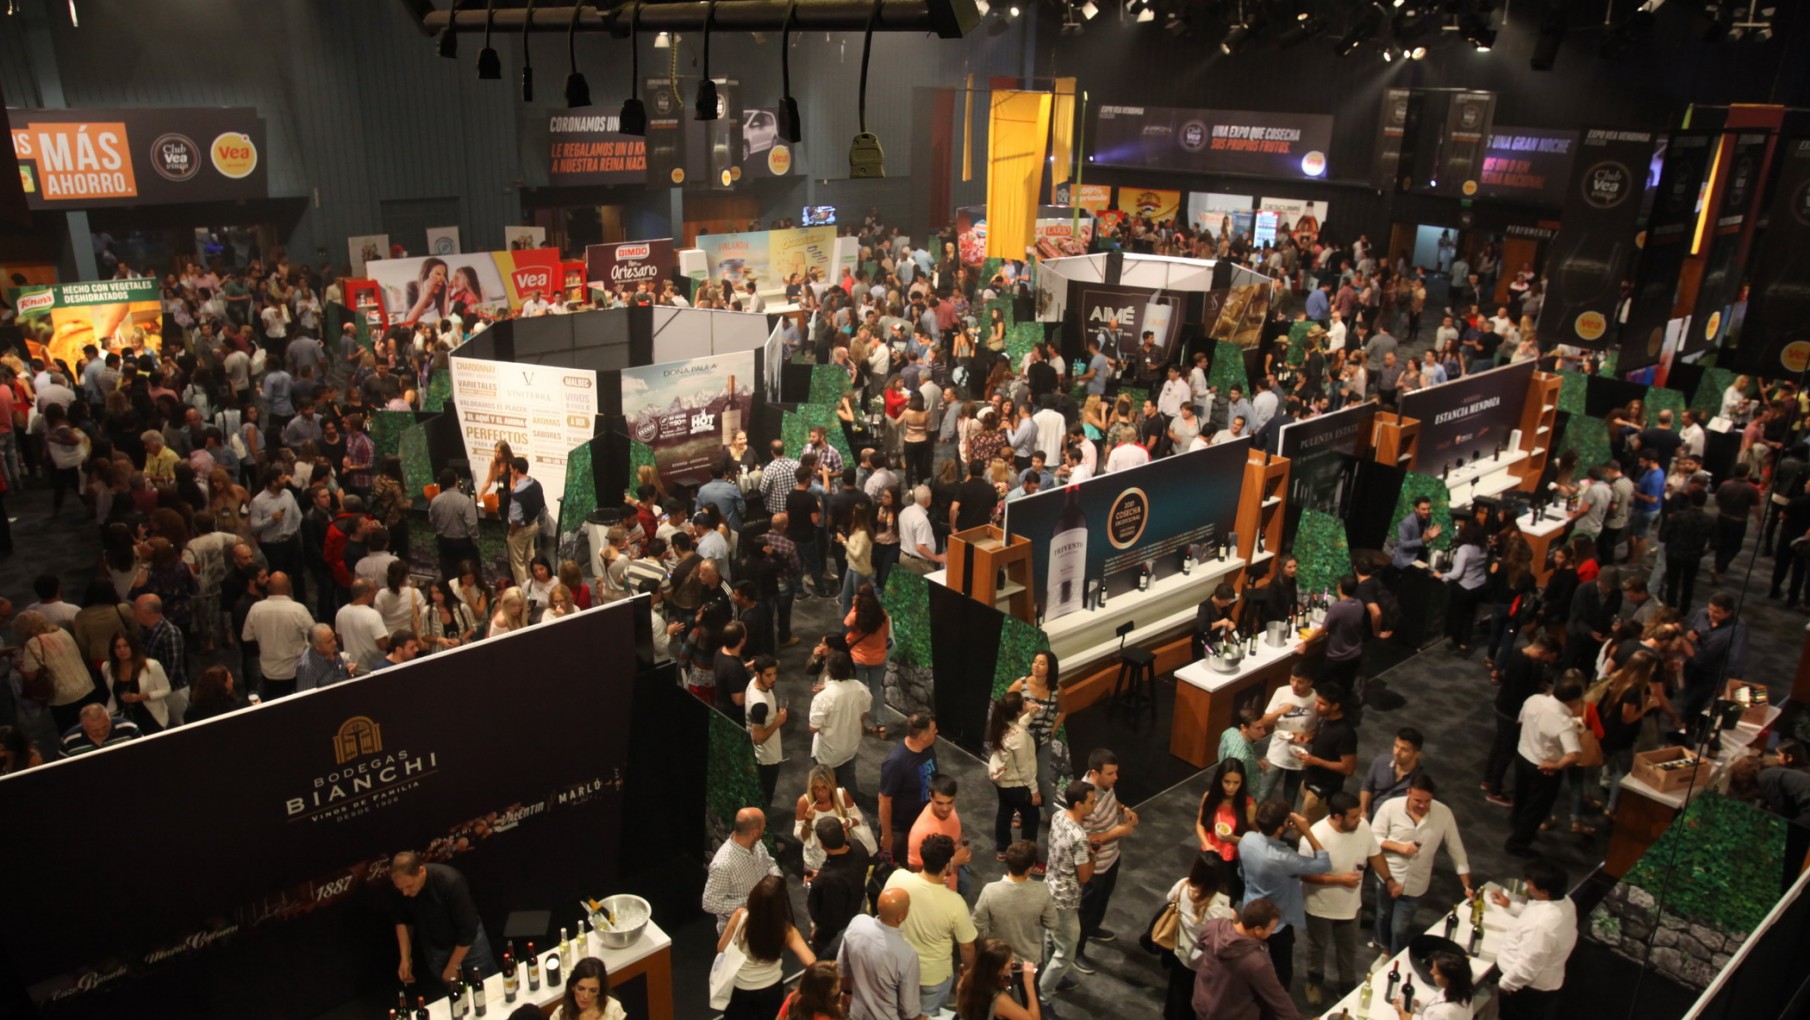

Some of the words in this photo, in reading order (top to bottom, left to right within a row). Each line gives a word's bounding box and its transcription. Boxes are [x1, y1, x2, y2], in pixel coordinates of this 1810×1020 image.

[550, 115, 607, 133] CORONAMOS
[1211, 124, 1229, 137] UNA
[1228, 125, 1249, 138] EXPO
[1249, 125, 1265, 141] QUE
[1265, 127, 1301, 142] COSECHA
[38, 125, 122, 172] MÁS
[162, 143, 187, 154] Club
[218, 145, 250, 161] Vea
[551, 143, 563, 158] LE
[563, 142, 614, 158] REGALAMOS
[614, 141, 627, 157] UN
[1492, 135, 1512, 150] UNA
[1511, 136, 1539, 152] GRAN
[1537, 138, 1571, 155] NOCHE
[164, 153, 188, 164] Vea
[551, 159, 559, 173] A
[559, 157, 598, 173] NUESTRA
[599, 156, 625, 172] REINA
[1594, 168, 1621, 181] Club
[48, 172, 133, 195] AHORRO.
[1593, 179, 1619, 192] Vea
[618, 247, 648, 257] BIMBO
[62, 284, 90, 296] HECHO
[91, 283, 109, 294] CON
[109, 280, 153, 293] VEGETALES
[516, 272, 547, 288] Vea
[64, 291, 129, 304] DESHIDRATADOS
[1089, 305, 1135, 325] AIMÉ
[456, 361, 496, 374] CHARDONNAY
[690, 363, 718, 374] PAULA
[457, 379, 497, 391] VARIETALES
[565, 376, 589, 389] MALBEC
[459, 399, 496, 409] VALORAMOS
[565, 392, 590, 403] VINOS
[1434, 406, 1469, 425] ESTANCIA
[1469, 395, 1500, 415] MENDOZA
[532, 416, 561, 427] AROMAS
[691, 413, 715, 428] HOT
[465, 426, 529, 445] PERFECTOS
[533, 430, 562, 441] SABORES
[1299, 432, 1333, 450] PULENTA
[1334, 423, 1360, 439] ESTATE
[1115, 506, 1141, 520] COSECHA
[1054, 542, 1084, 557] TRIVENTO
[313, 750, 409, 788] BODEGAS
[286, 752, 437, 816] BIANCHI
[558, 777, 602, 804] MARLÓ
[311, 806, 348, 822] VINOS
[352, 799, 367, 808] DE
[372, 781, 420, 801] FAMILIA
[315, 874, 354, 902] 1887
